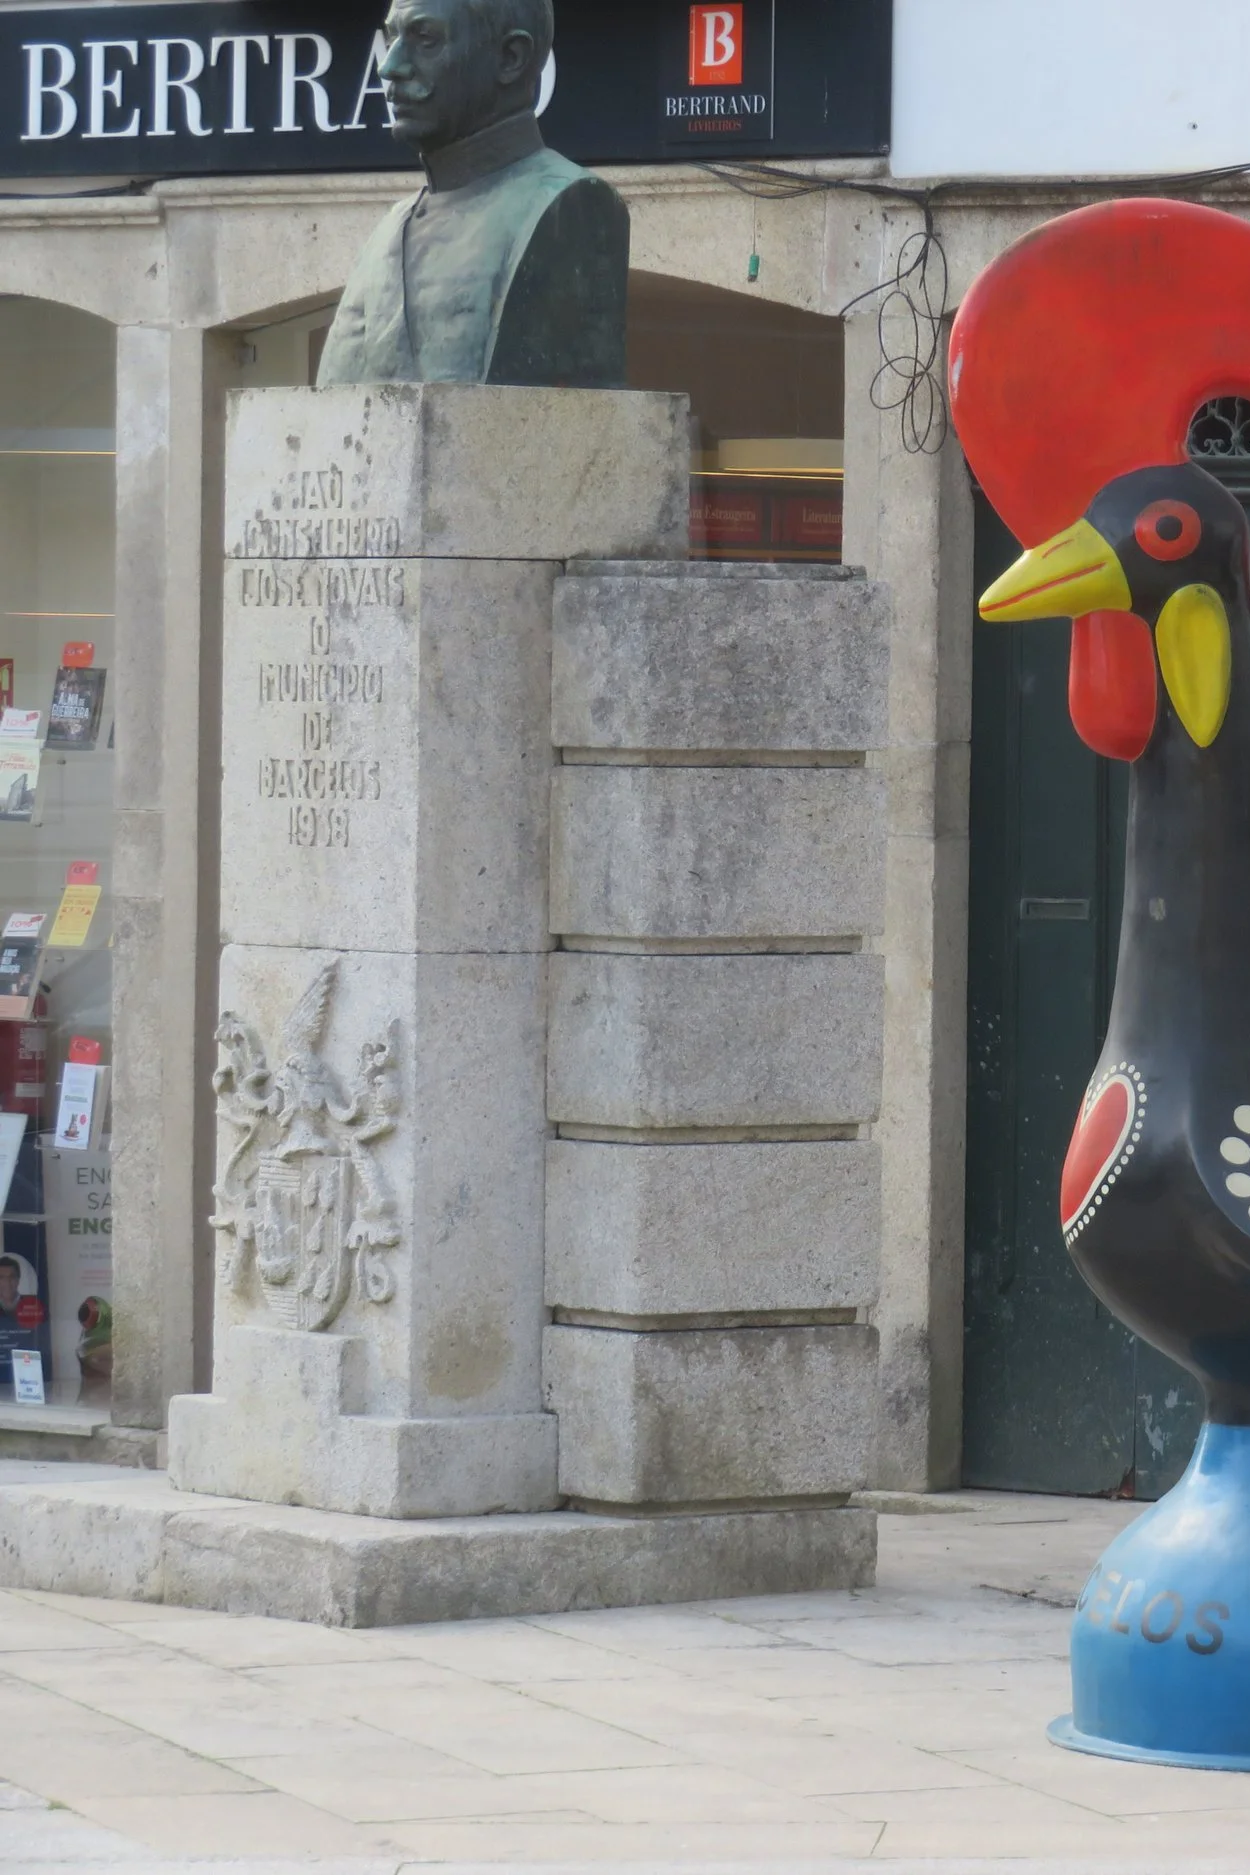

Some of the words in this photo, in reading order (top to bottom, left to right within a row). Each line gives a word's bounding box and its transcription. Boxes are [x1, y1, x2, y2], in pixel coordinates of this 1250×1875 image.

[702, 11, 735, 67] B
[20, 30, 557, 141] BERTRA
[665, 94, 766, 117] BERTRAND
[802, 507, 842, 523] Literatur
[303, 712, 333, 750] DE
[259, 759, 381, 800] BARCELOS
[87, 1192, 111, 1210] SA
[68, 1217, 112, 1235] ENG
